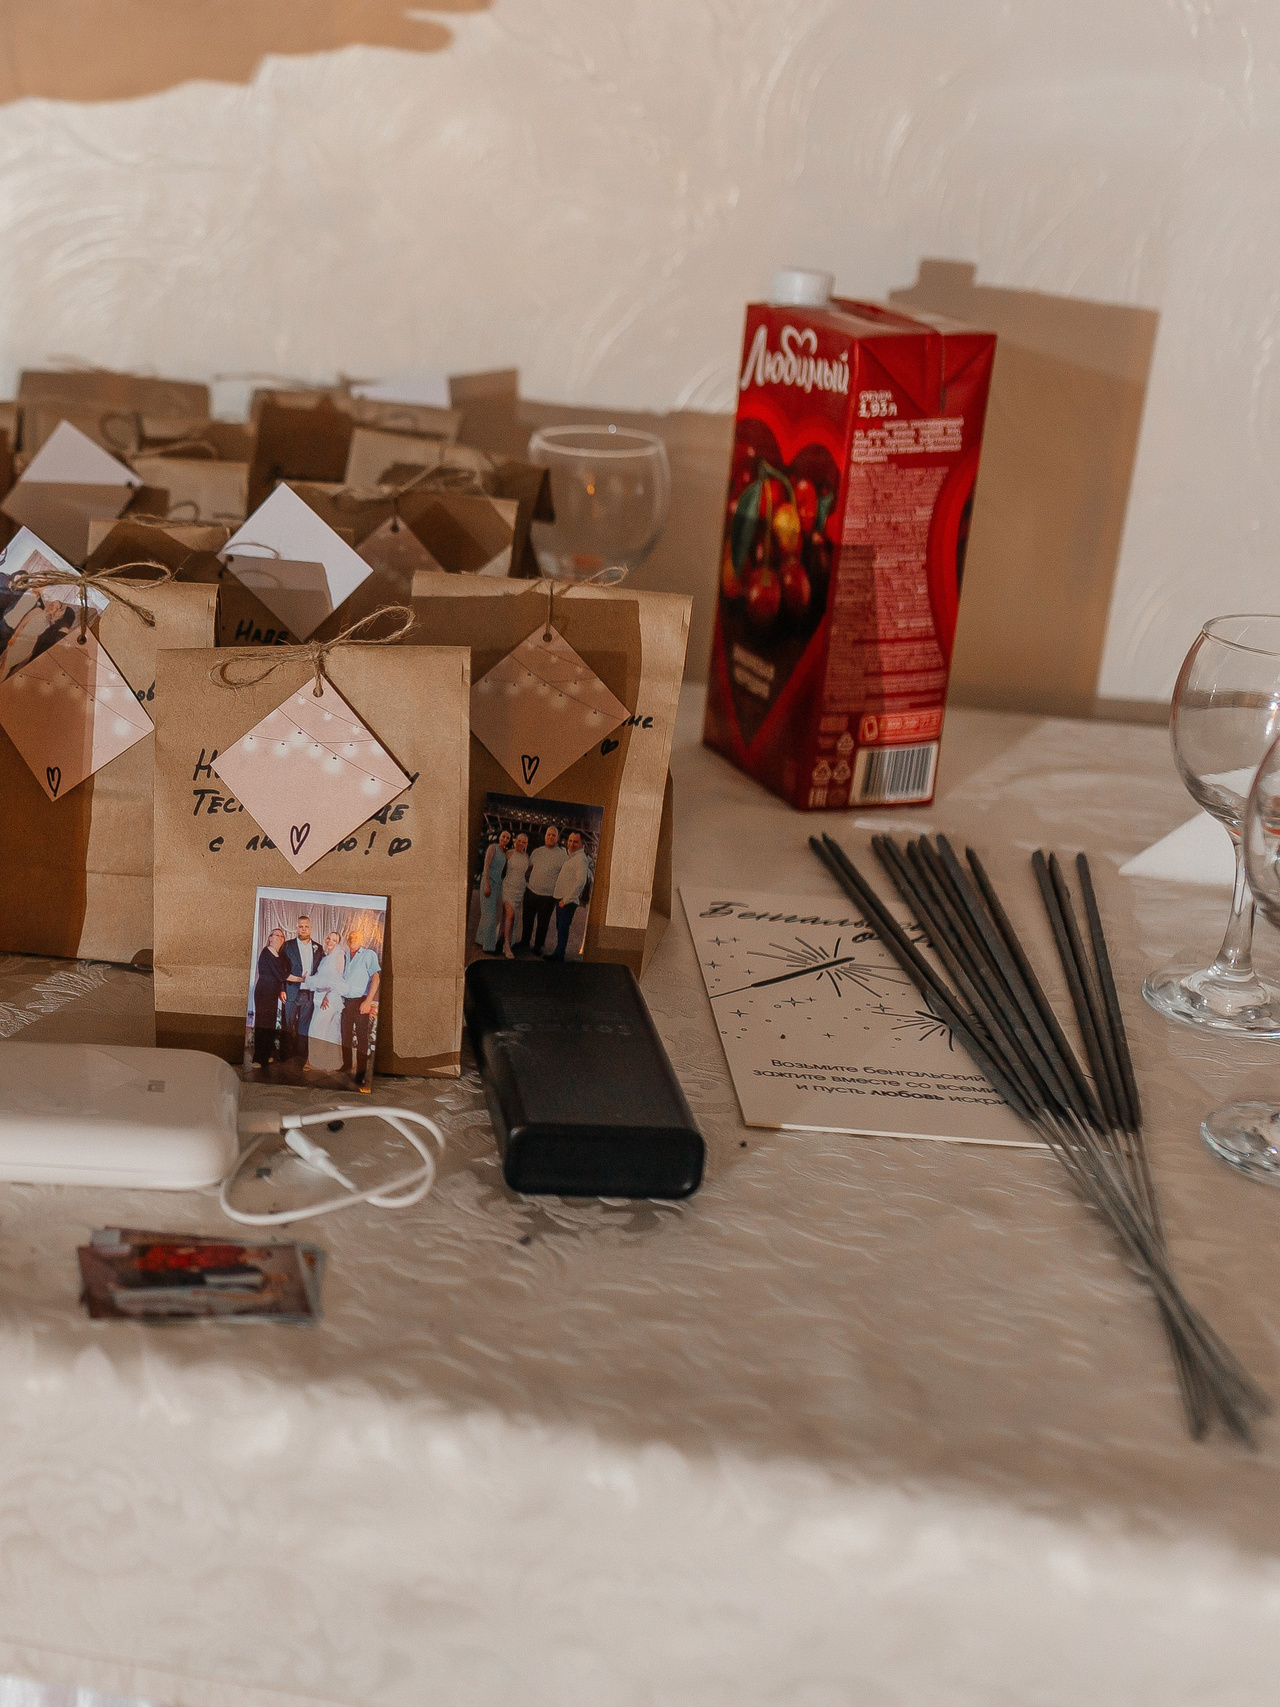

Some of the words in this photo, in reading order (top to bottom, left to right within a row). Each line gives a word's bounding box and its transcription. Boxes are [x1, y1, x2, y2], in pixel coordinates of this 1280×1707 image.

[739, 324, 850, 395] Любимый
[753, 1069, 826, 1081] зажгите
[831, 1076, 901, 1087] вместе
[905, 1081, 931, 1089] со
[936, 1084, 998, 1095] всеми
[771, 1059, 859, 1073] Возьмите
[863, 1066, 987, 1083] бенгальский
[813, 1085, 866, 1095] пусть
[871, 1089, 945, 1101] любовь
